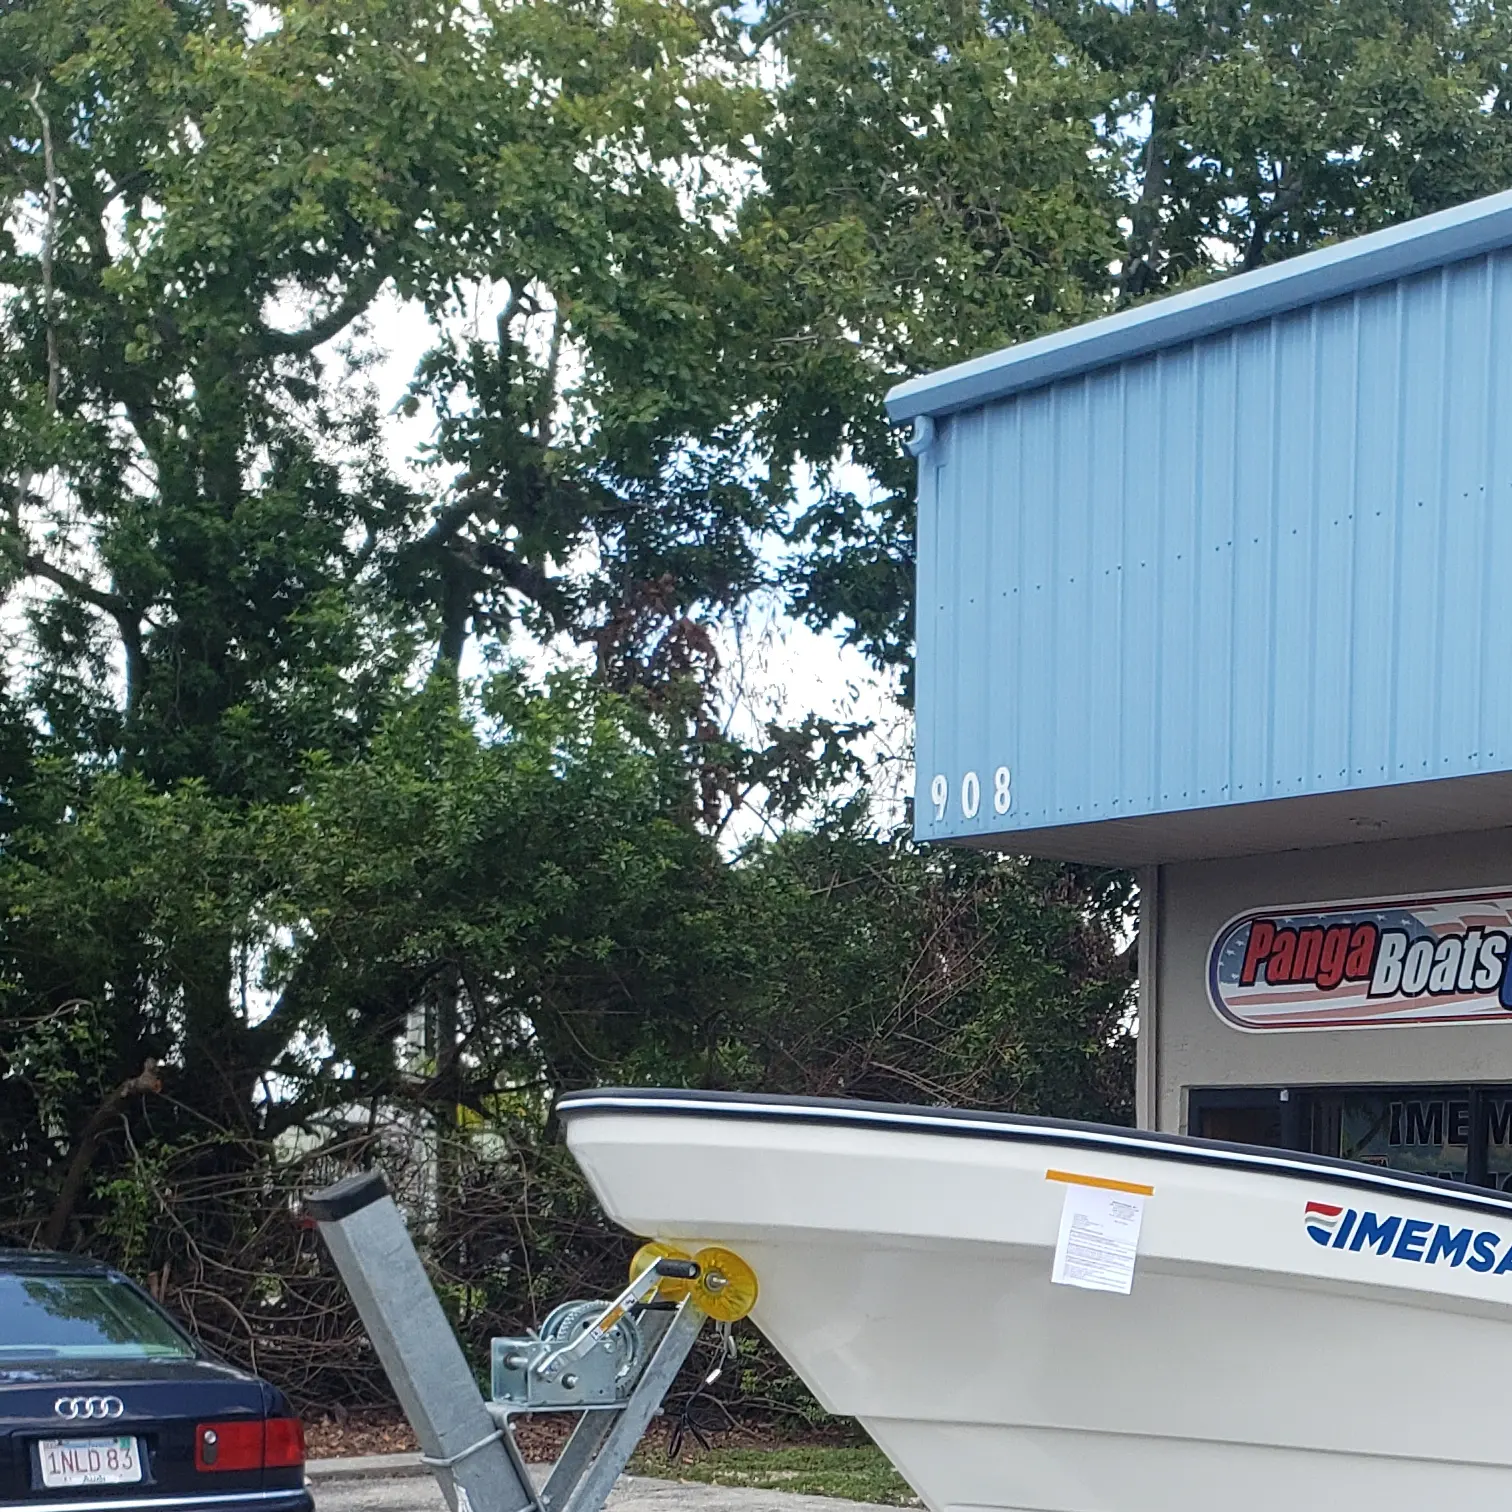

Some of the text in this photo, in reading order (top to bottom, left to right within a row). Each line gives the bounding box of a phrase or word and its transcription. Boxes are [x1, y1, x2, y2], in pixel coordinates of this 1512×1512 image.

[931, 766, 1011, 821] 908
[1239, 919, 1379, 991] Panga
[1367, 926, 1508, 999] Boats
[48, 1448, 133, 1475] 1NLD 83
